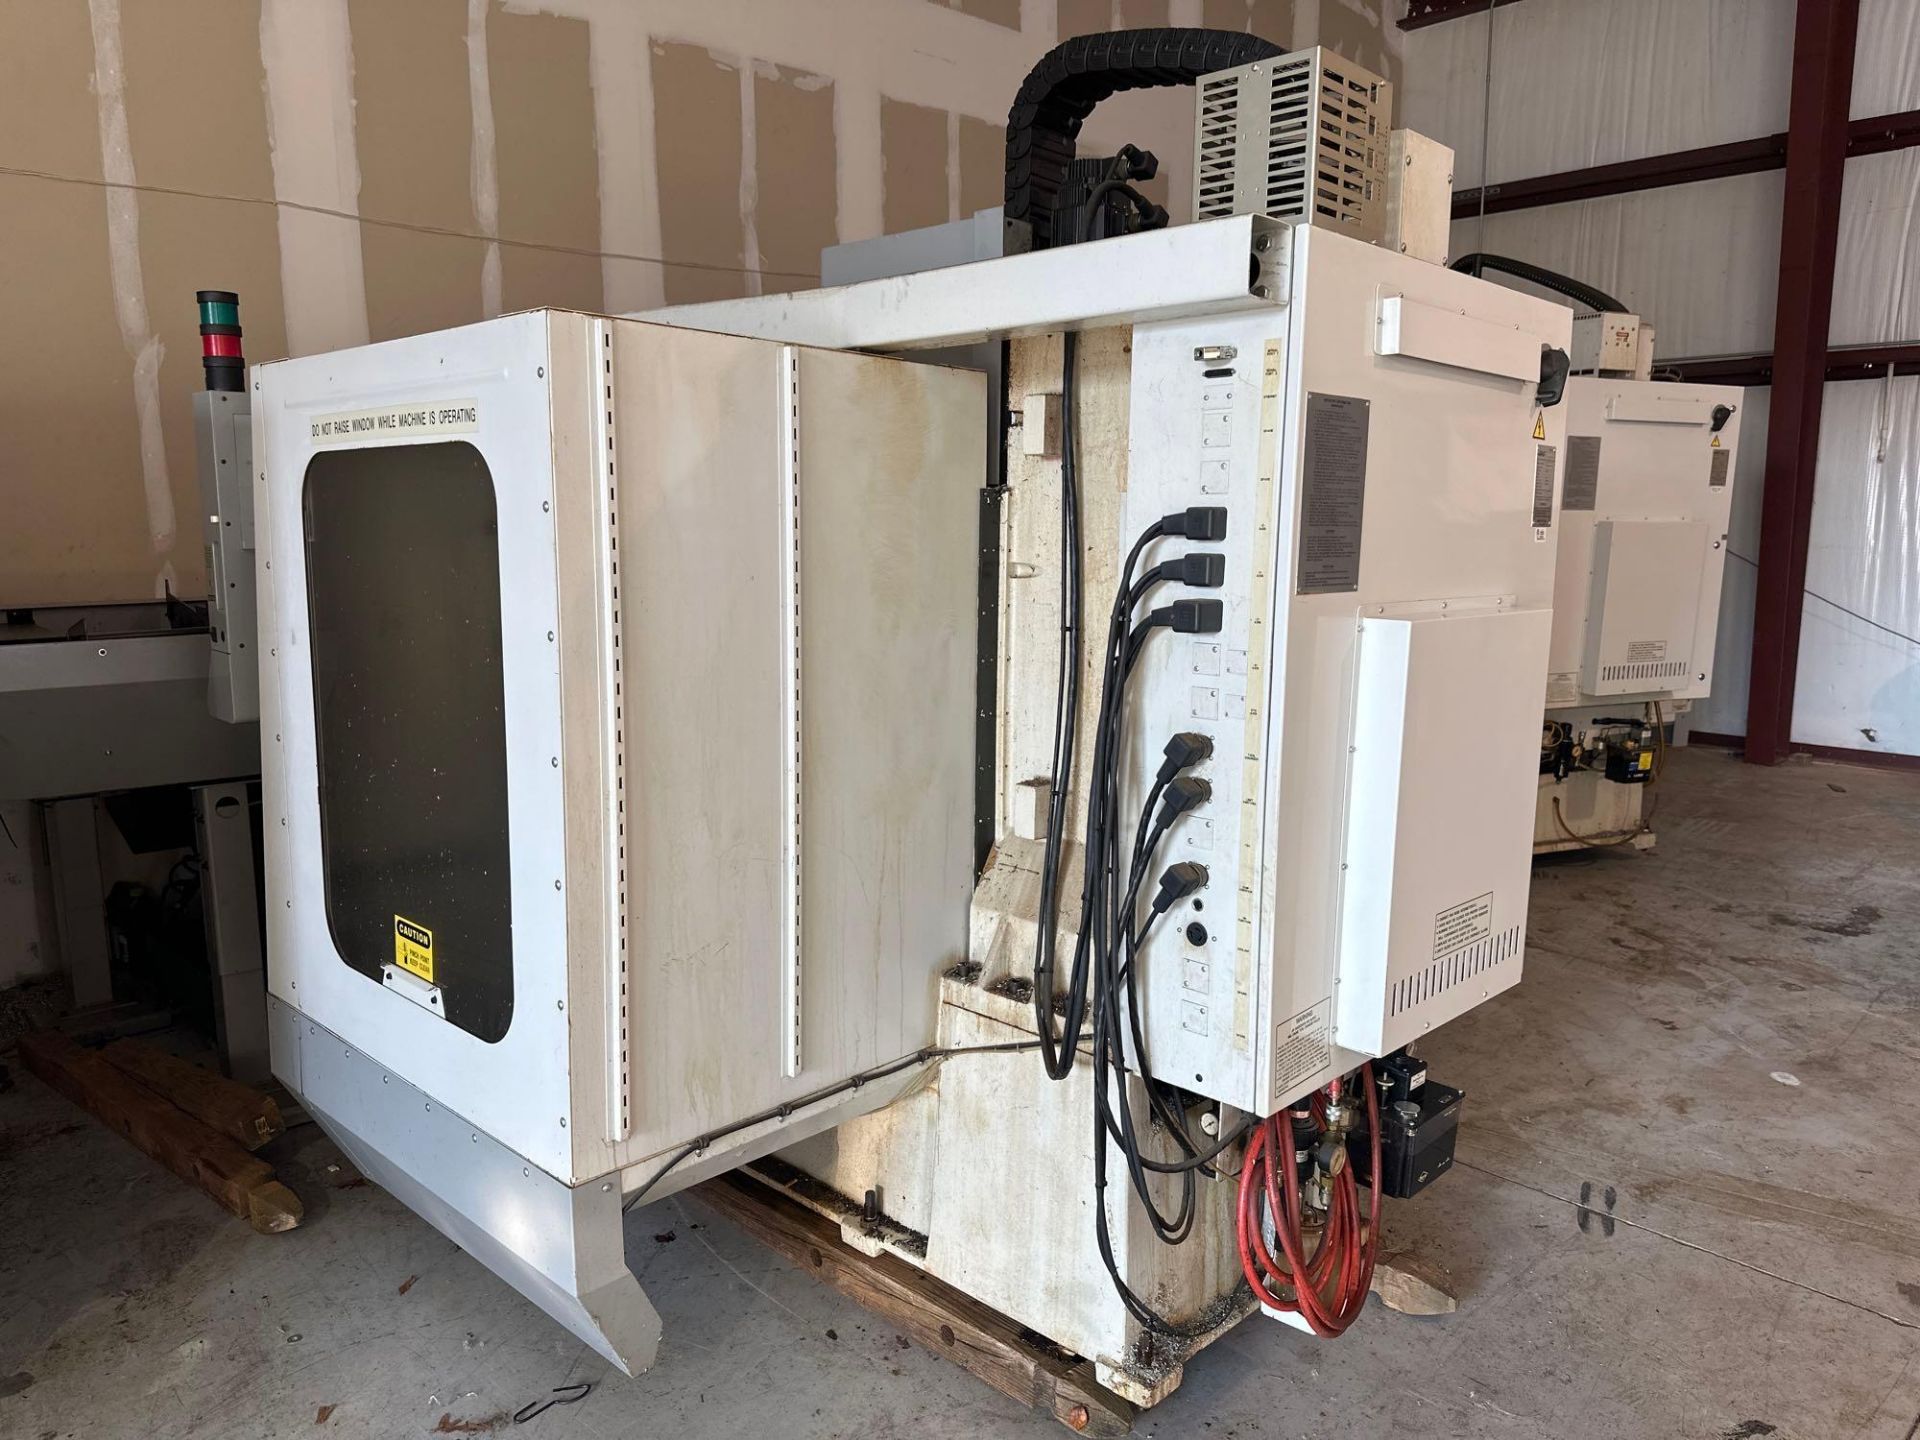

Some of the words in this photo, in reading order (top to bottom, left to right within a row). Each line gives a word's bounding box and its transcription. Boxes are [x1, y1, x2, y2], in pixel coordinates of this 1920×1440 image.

[312, 424, 320, 437] DO
[322, 422, 332, 436] NOT
[334, 420, 350, 434] RAISE
[352, 417, 375, 432] WINDOW
[377, 414, 396, 429] WHILE
[398, 412, 426, 428] MACHINE
[429, 410, 436, 425] IS
[438, 407, 476, 425] OPERATING
[399, 924, 428, 945] CAUTION
